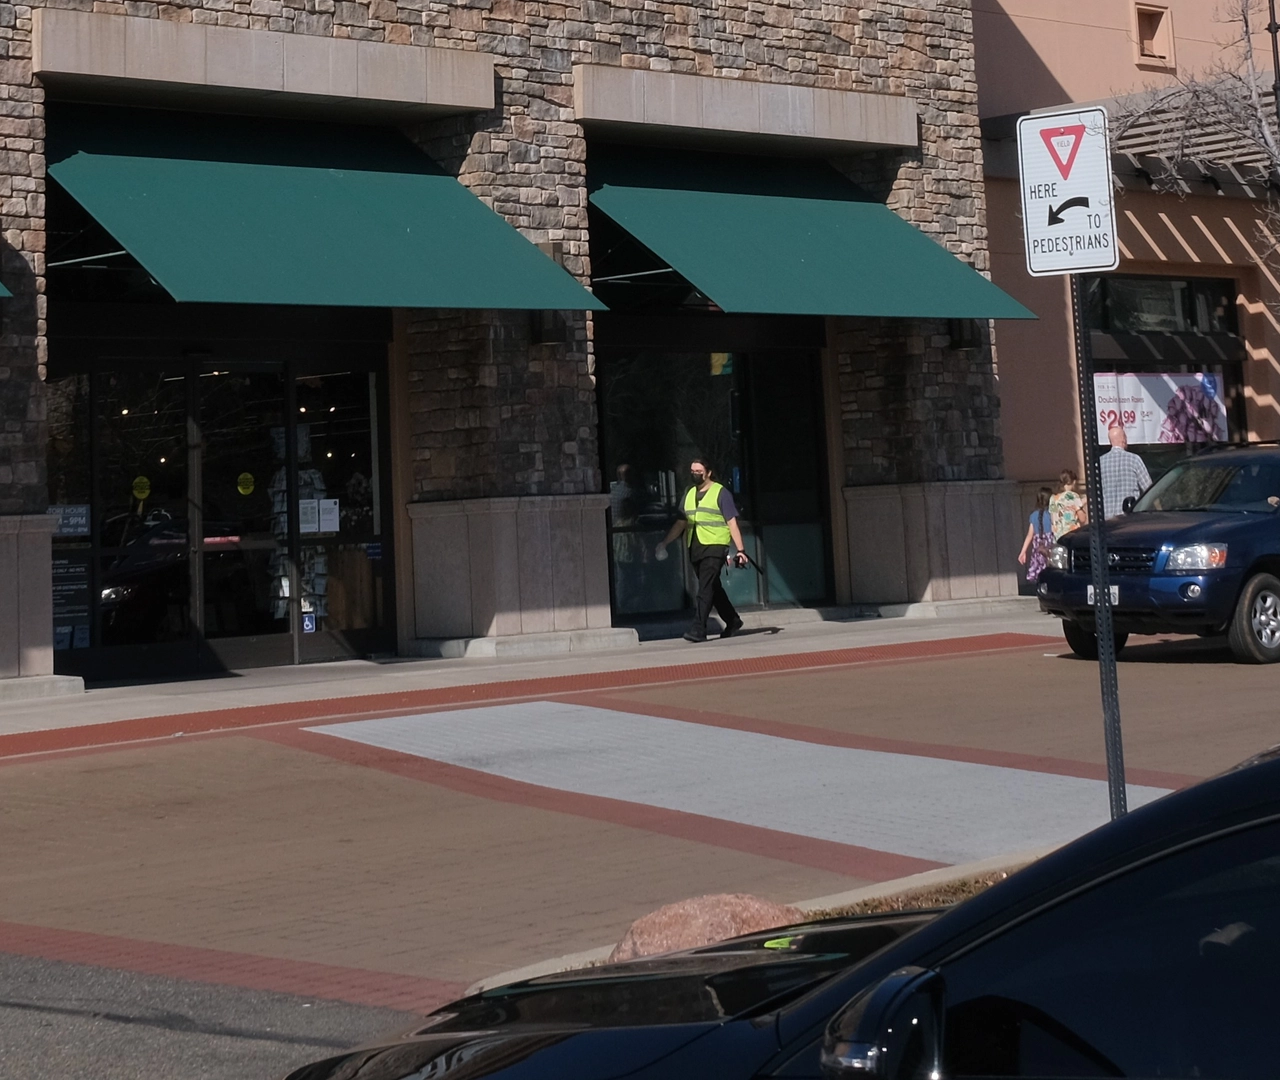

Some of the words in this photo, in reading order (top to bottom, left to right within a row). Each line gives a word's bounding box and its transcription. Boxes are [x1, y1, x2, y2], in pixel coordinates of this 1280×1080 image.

[1056, 139, 1070, 148] YIELD
[1029, 182, 1058, 200] HERE
[1086, 213, 1101, 229] TO
[1032, 233, 1109, 254] PEDESTRIANS
